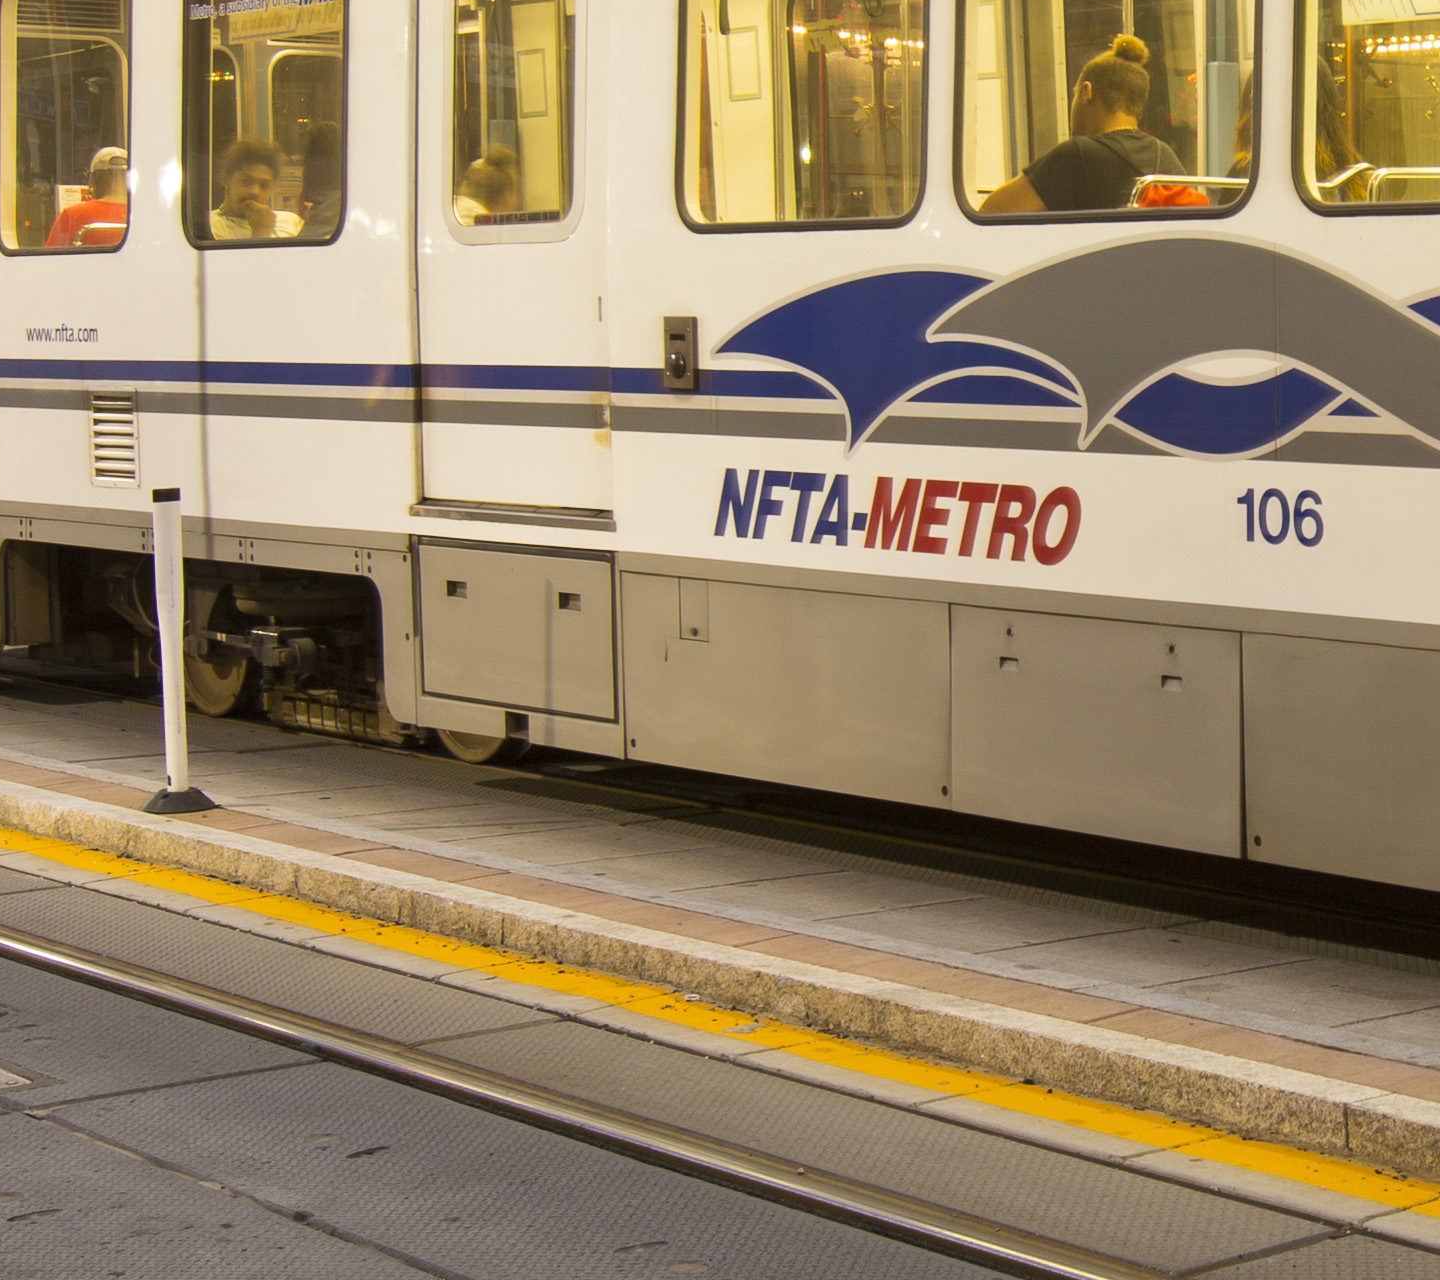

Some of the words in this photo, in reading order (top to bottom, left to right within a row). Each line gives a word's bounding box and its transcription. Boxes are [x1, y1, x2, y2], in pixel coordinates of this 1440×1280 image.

[26, 322, 98, 343] www.nfta.com
[714, 467, 1082, 567] NFTA-METRO
[1236, 487, 1325, 549] 106
